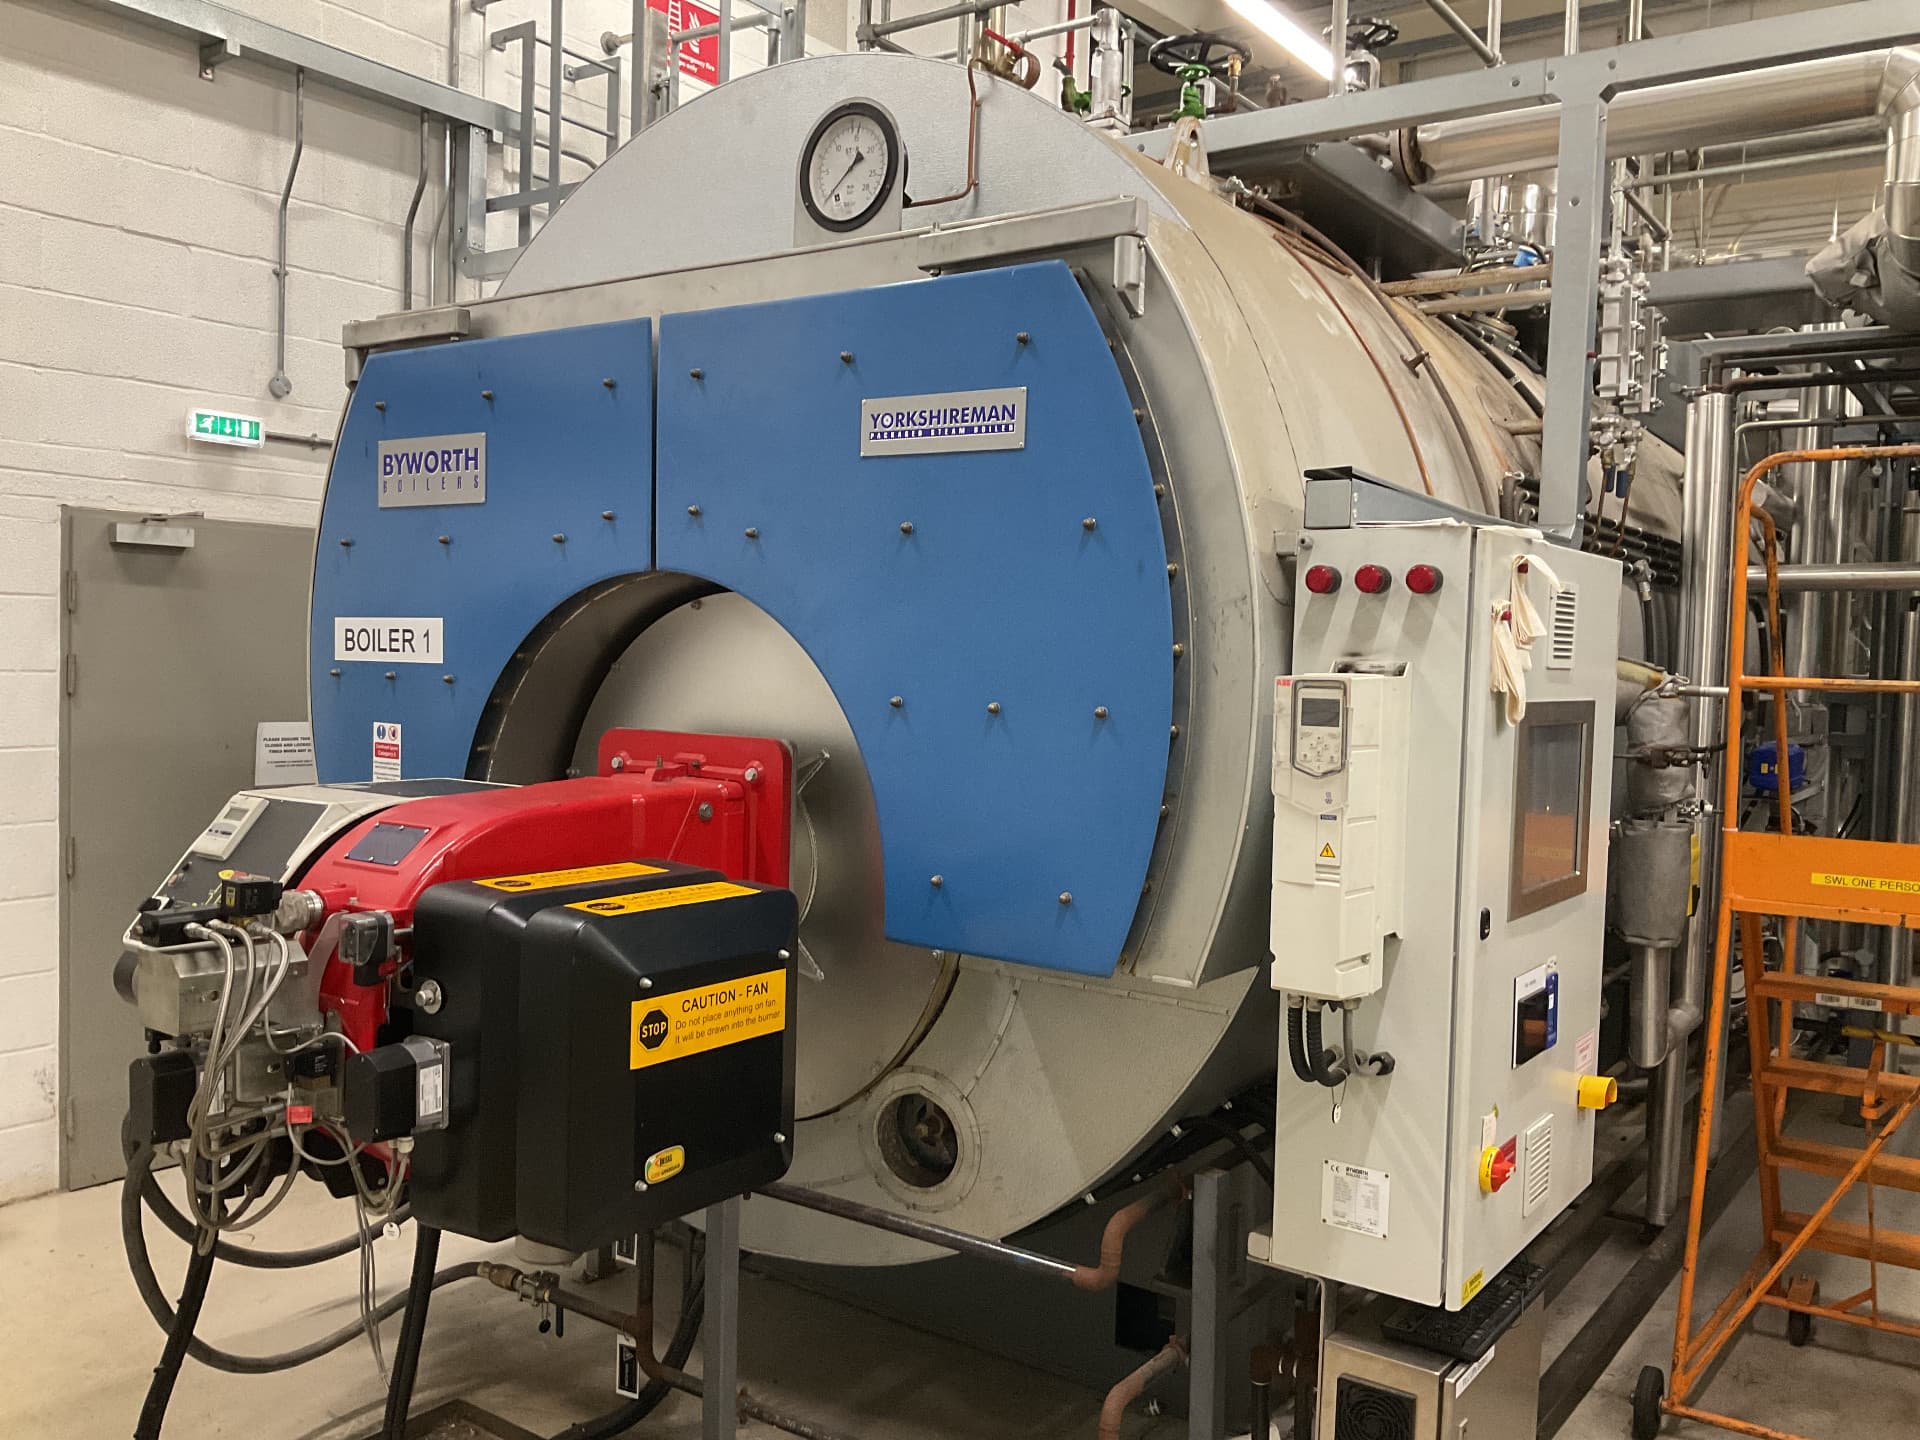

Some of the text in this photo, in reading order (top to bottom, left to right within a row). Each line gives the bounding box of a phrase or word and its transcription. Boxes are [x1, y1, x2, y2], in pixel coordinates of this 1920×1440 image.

[870, 403, 1016, 429] YORKSHIREMAN
[930, 427, 965, 437] STEAM
[383, 447, 479, 476] BYWORTH
[383, 475, 479, 494] BOILERS
[344, 628, 430, 653] BOILER 1
[1824, 875, 1849, 886] SWL
[1852, 877, 1877, 889] ONE
[682, 989, 736, 1013] CAUTION
[746, 981, 769, 998] FAN
[675, 1020, 686, 1030] Do
[689, 1016, 701, 1026] not
[702, 1012, 722, 1026] place
[724, 1004, 753, 1020] anything
[755, 1001, 763, 1010] on
[641, 1021, 667, 1038] STOP
[682, 1031, 694, 1042] will
[695, 1029, 706, 1039] be
[707, 1024, 729, 1036] drawn
[731, 1020, 744, 1030] into
[745, 1016, 757, 1026] the
